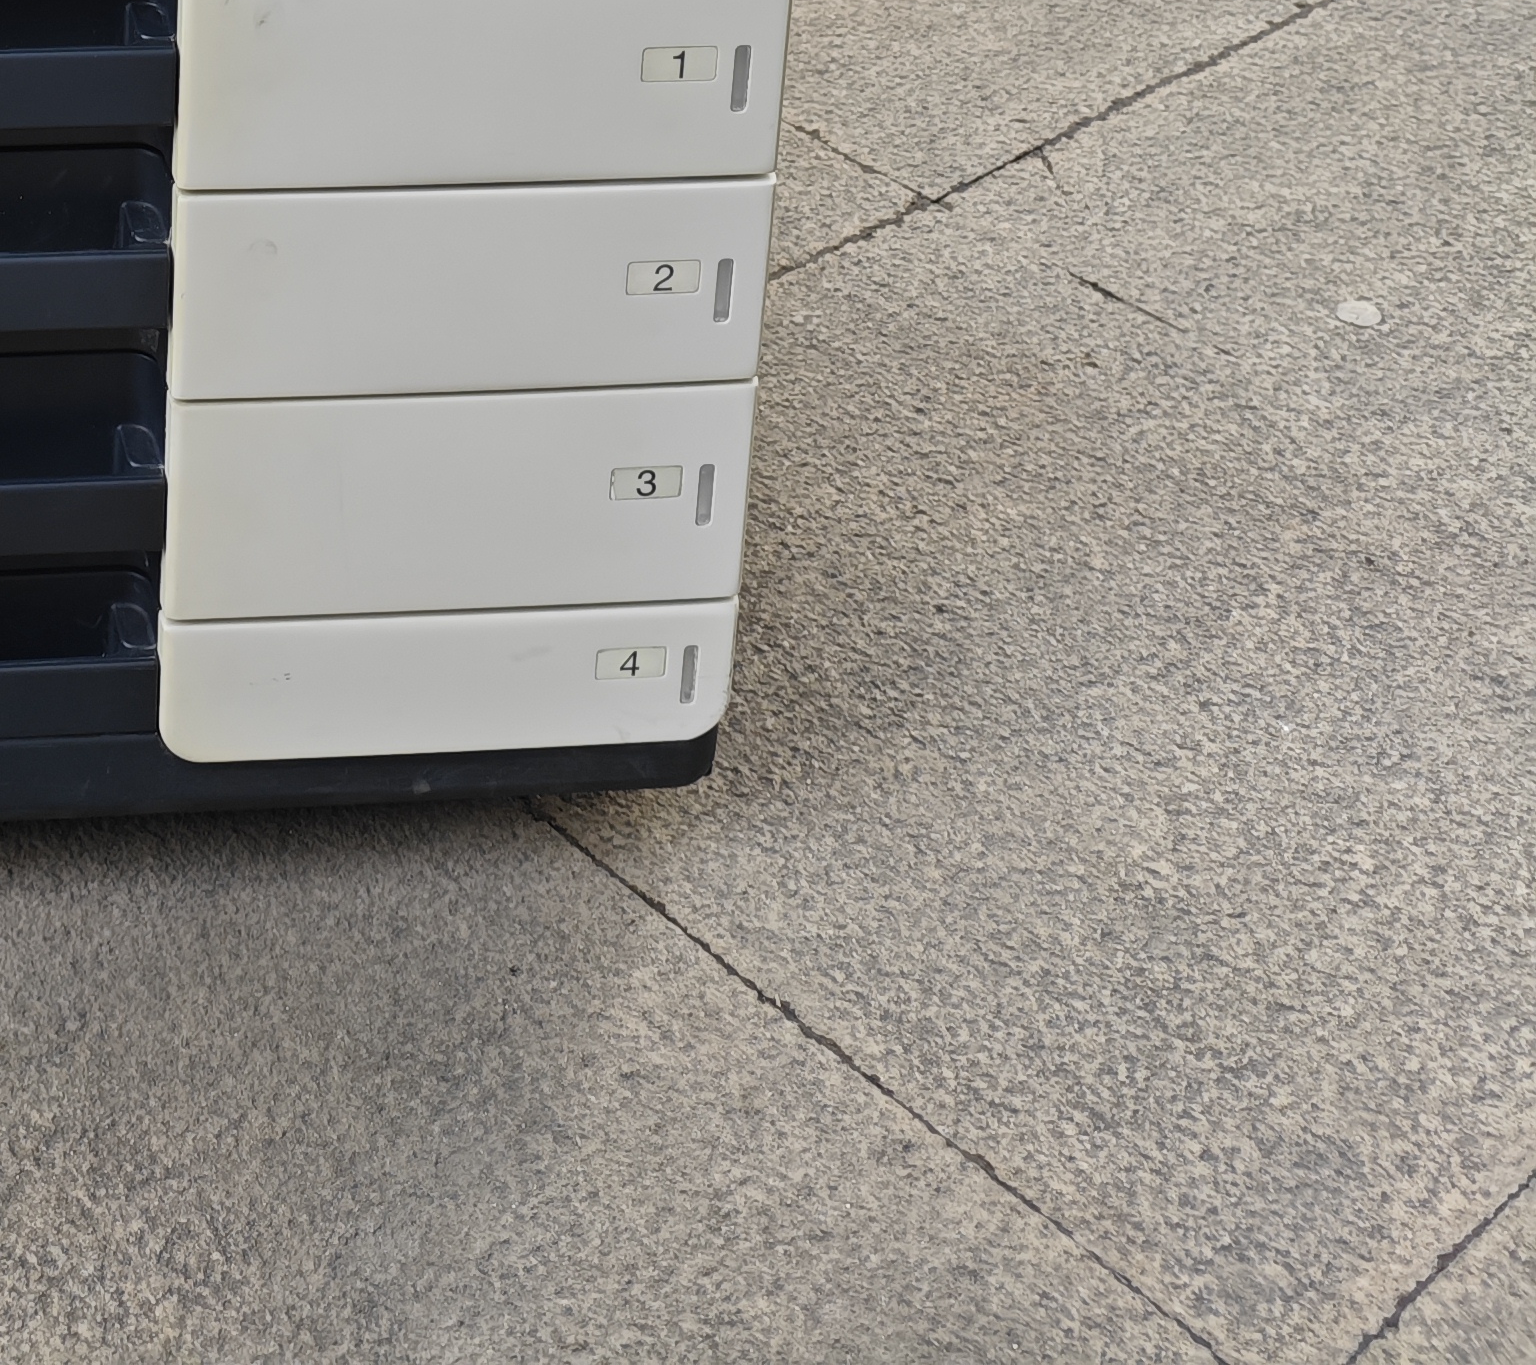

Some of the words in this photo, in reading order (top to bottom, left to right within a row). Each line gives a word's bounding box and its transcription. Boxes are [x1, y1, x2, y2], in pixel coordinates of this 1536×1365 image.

[672, 50, 686, 79] 1
[652, 263, 675, 292] 2
[635, 469, 657, 497] 3
[619, 650, 640, 677] 4
